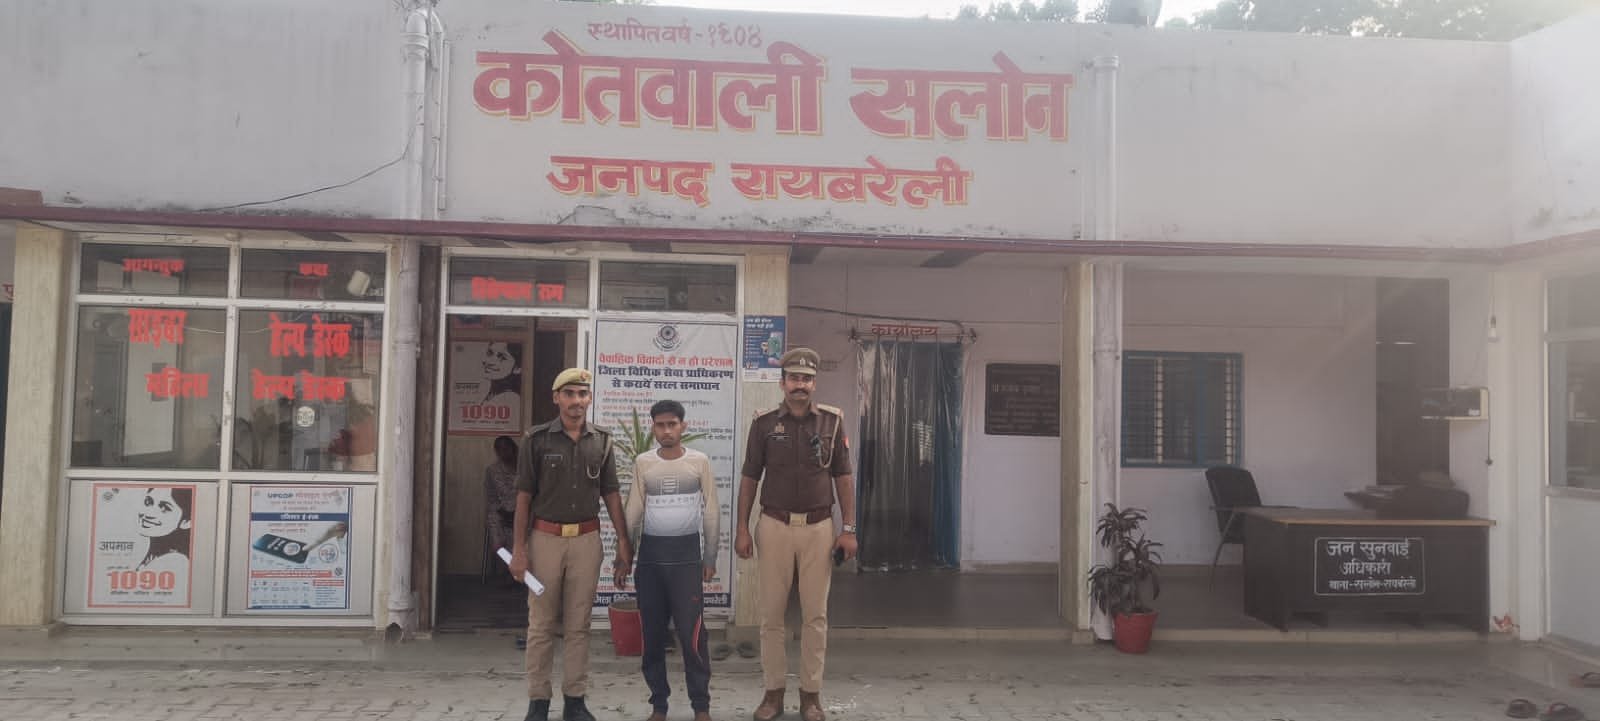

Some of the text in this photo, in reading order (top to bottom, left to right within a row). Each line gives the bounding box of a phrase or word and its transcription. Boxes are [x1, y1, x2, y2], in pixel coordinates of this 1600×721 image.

[472, 30, 1074, 141] कोतवाली सलोन
[546, 155, 973, 208] जनपद रायबरेली
[268, 313, 308, 358] हेल्प
[312, 314, 353, 359] डेस्क
[145, 366, 210, 400] महिला
[598, 366, 626, 376] जिला
[462, 405, 510, 420] 1090
[1328, 537, 1409, 560] जन सुनवाई
[108, 571, 175, 592] 1090
